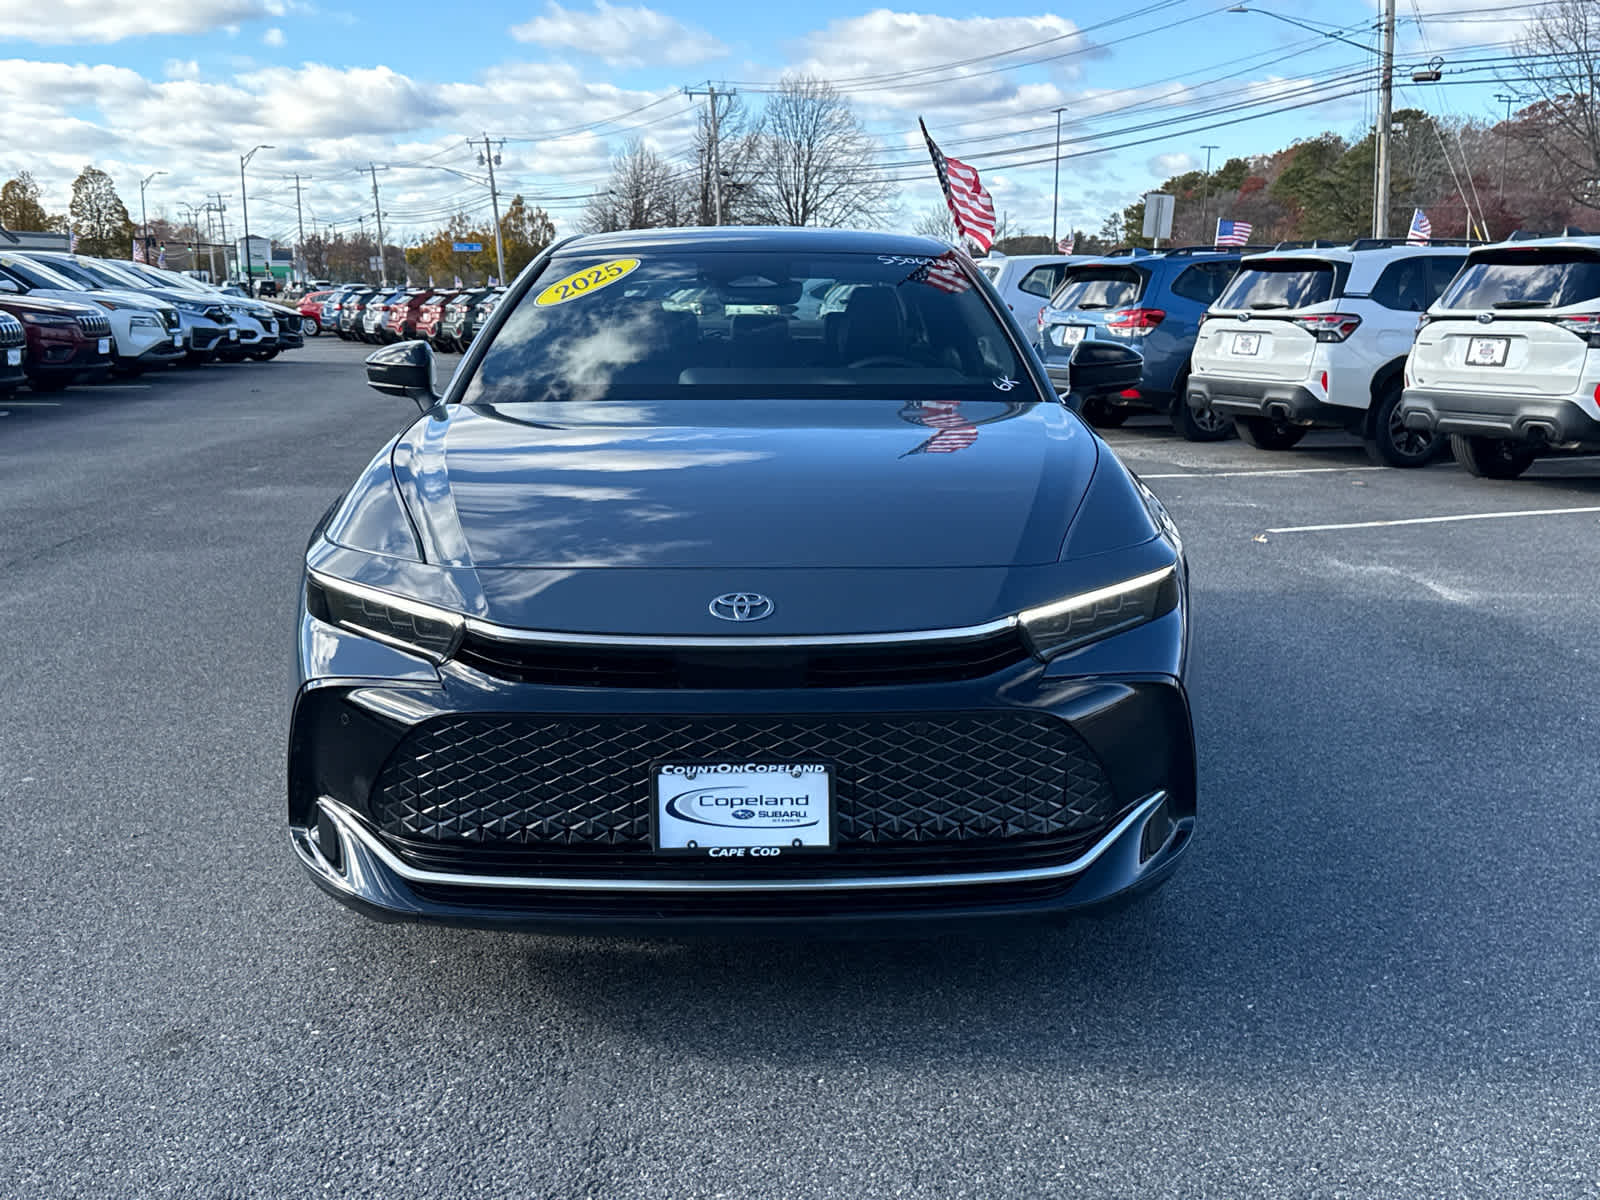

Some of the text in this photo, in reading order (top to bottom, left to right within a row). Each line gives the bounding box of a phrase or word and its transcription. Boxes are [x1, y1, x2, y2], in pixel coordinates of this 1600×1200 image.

[554, 263, 623, 300] 2025
[699, 794, 809, 808] Copeland
[758, 810, 807, 818] SUBARU
[708, 846, 781, 857] CAPE COD
